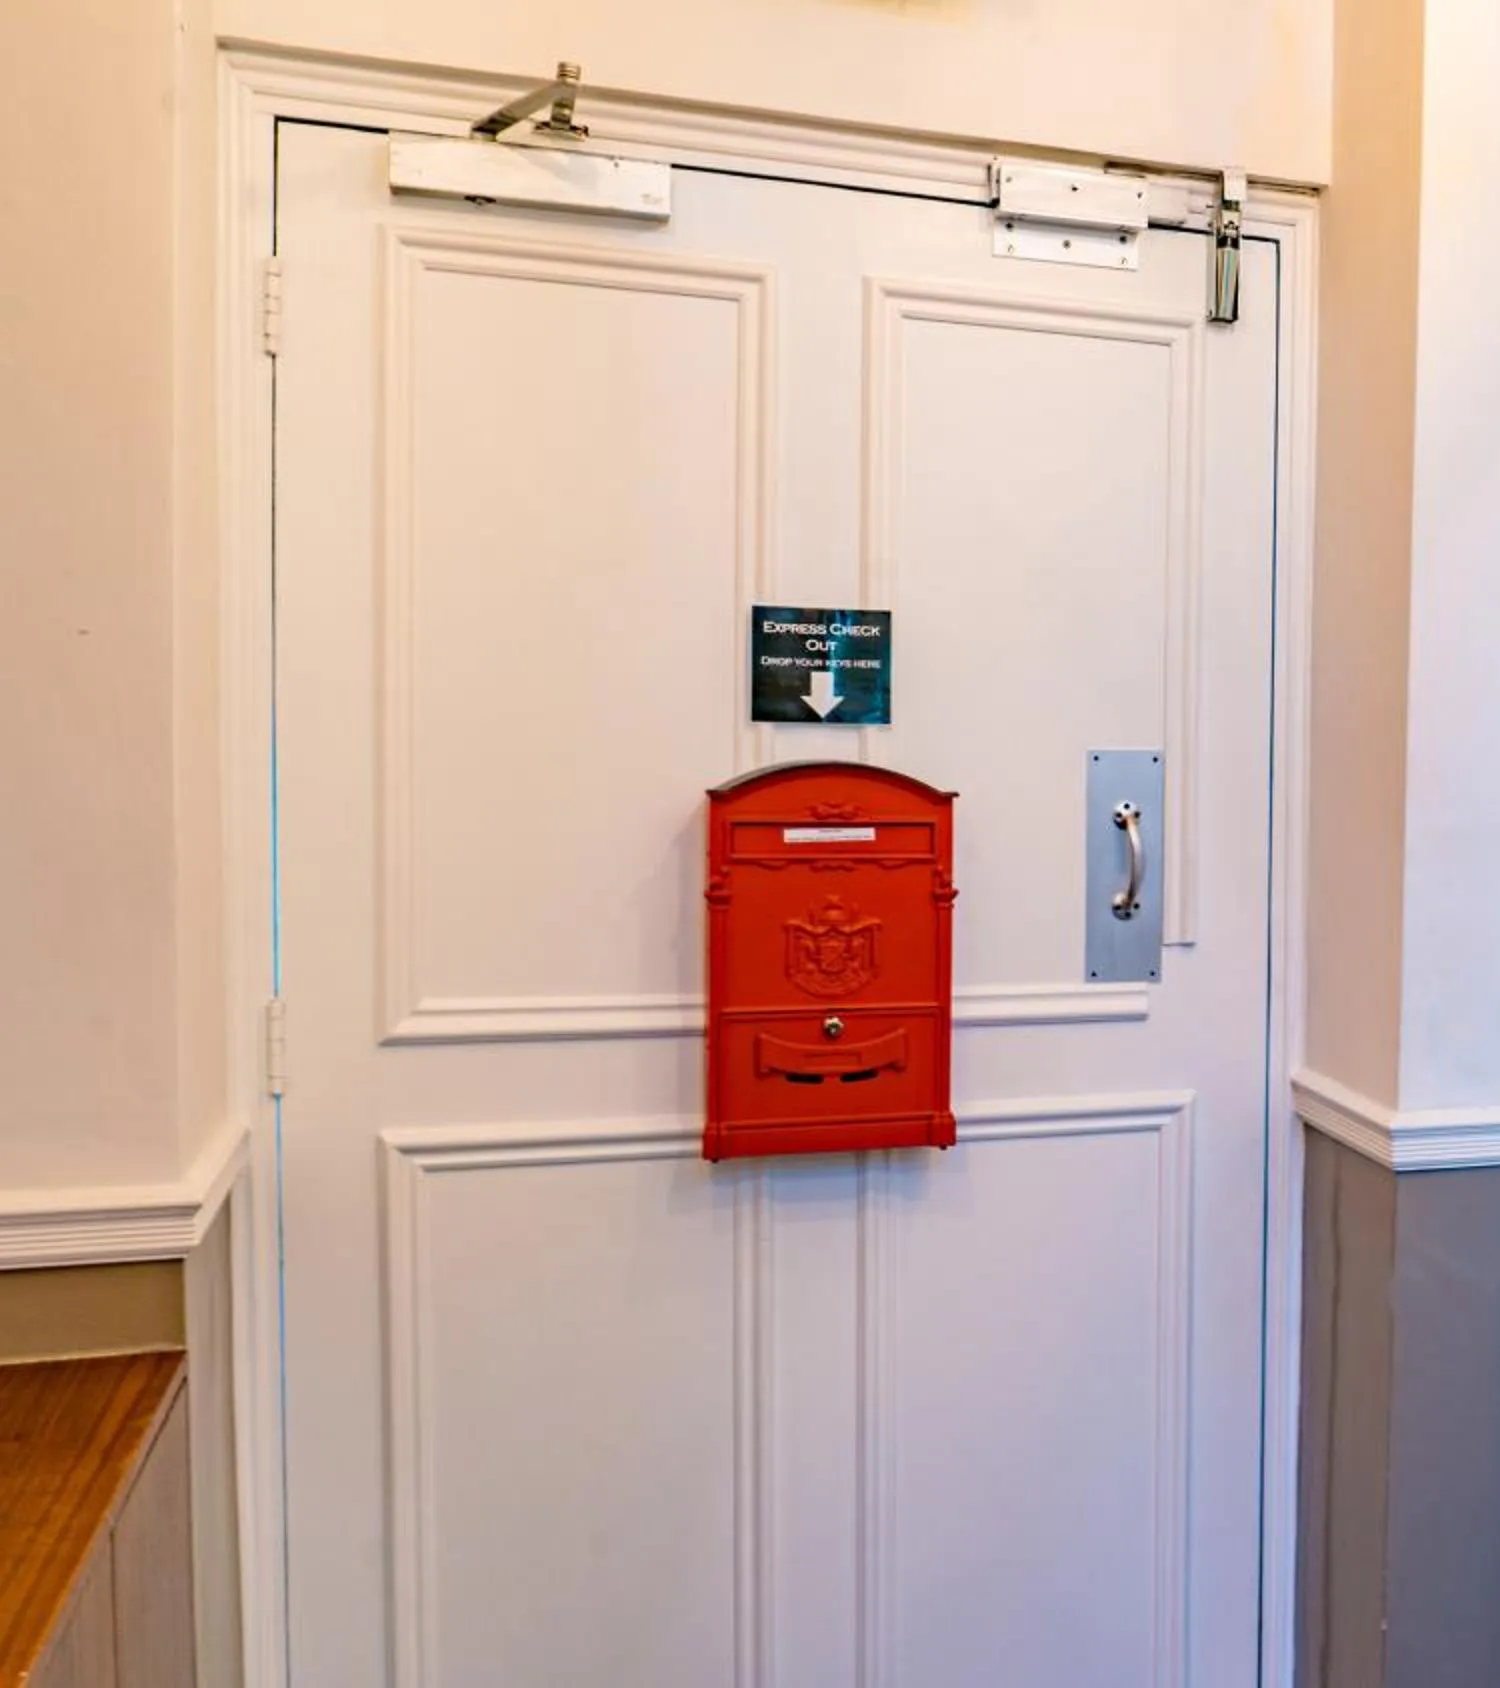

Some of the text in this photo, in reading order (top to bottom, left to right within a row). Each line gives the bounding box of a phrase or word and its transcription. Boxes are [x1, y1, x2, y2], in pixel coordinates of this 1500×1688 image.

[763, 620, 880, 636] EXPRESS CHECK
[805, 639, 837, 651] OUT
[760, 655, 792, 667] DROP
[795, 657, 822, 667] YOUR
[854, 660, 880, 669] HERE
